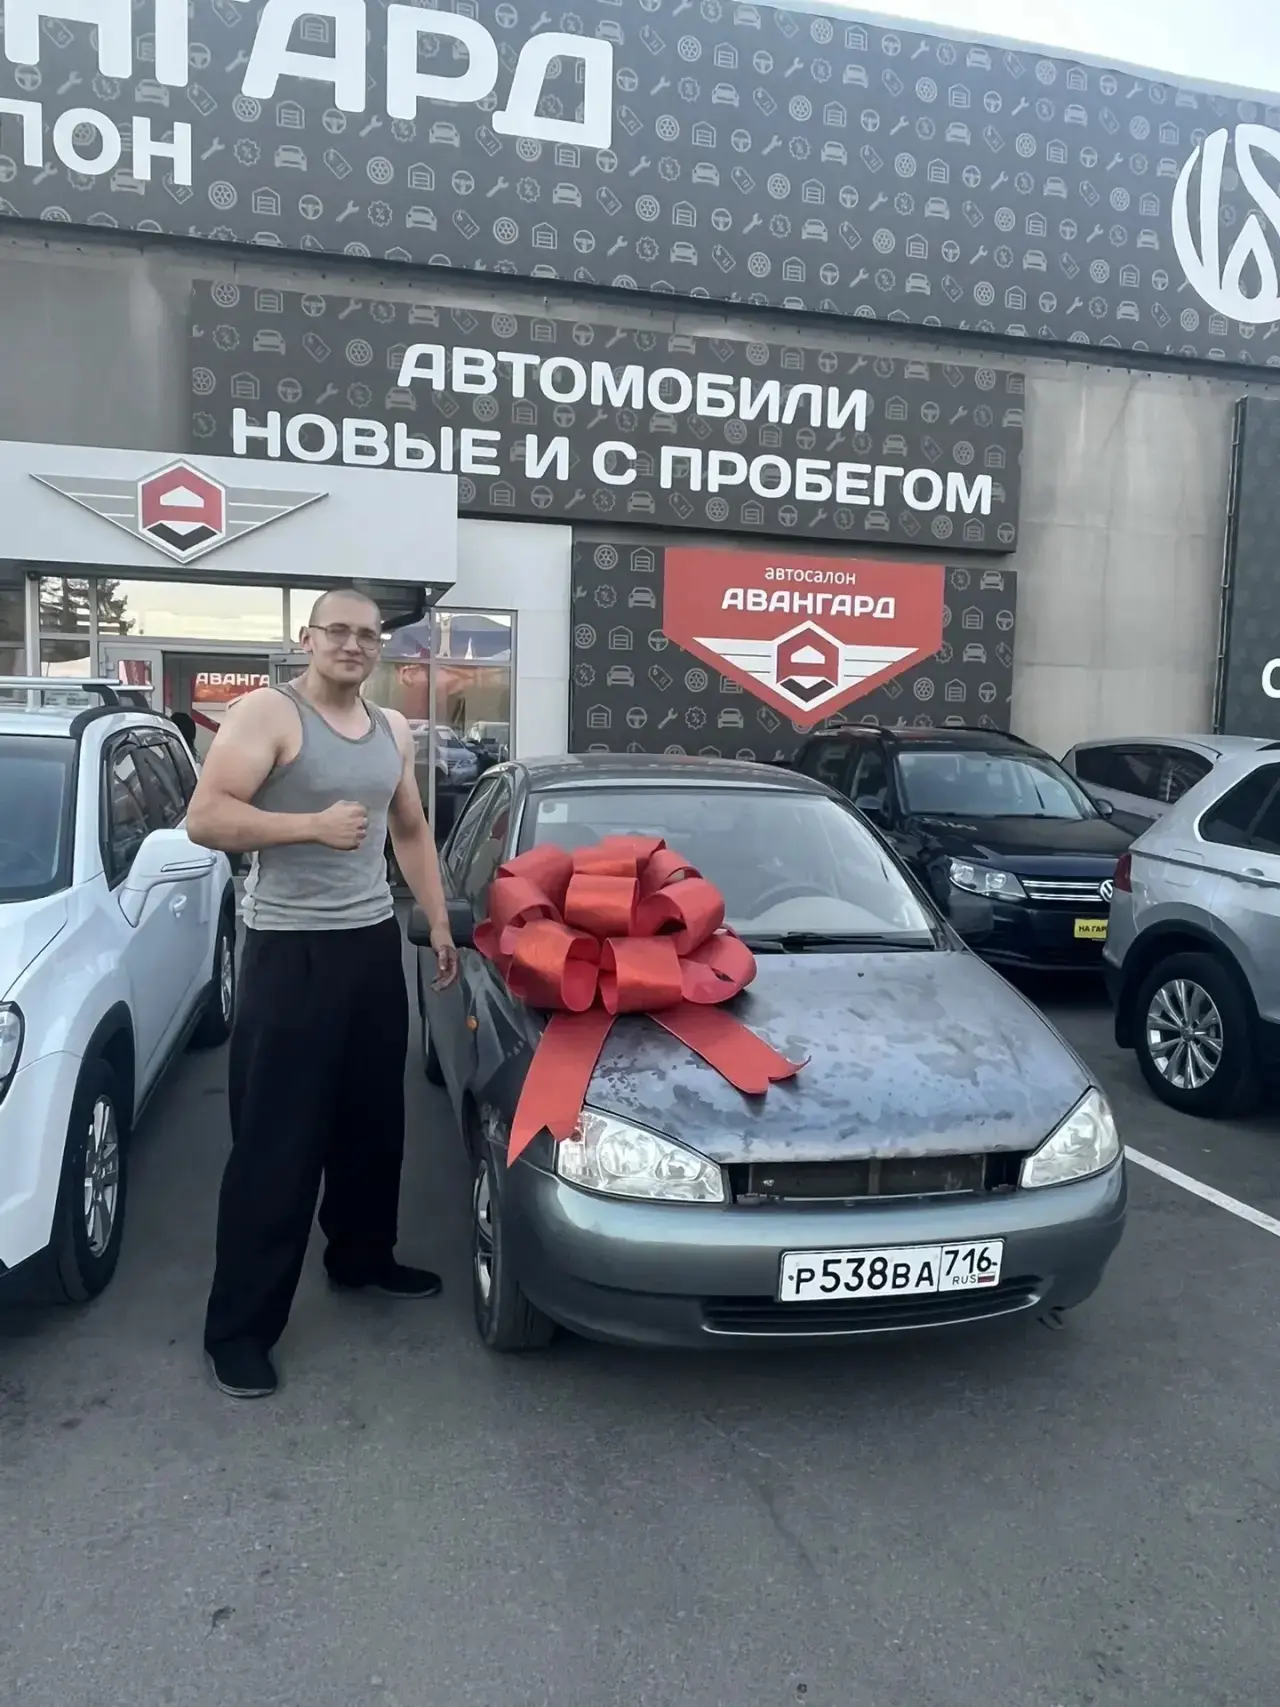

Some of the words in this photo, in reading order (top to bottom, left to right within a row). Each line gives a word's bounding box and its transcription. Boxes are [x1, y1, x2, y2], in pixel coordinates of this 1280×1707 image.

[398, 343, 867, 431] АВТОМОБИЛИ
[232, 407, 501, 476] НОВЫЕ
[524, 433, 570, 481] И
[592, 440, 638, 485] С
[660, 445, 992, 515] ПРОБЕГОМ
[765, 567, 856, 585] автосалон
[721, 588, 895, 619] АВАНГАРД
[945, 1247, 992, 1276] 716
[952, 1275, 977, 1285] RUS
